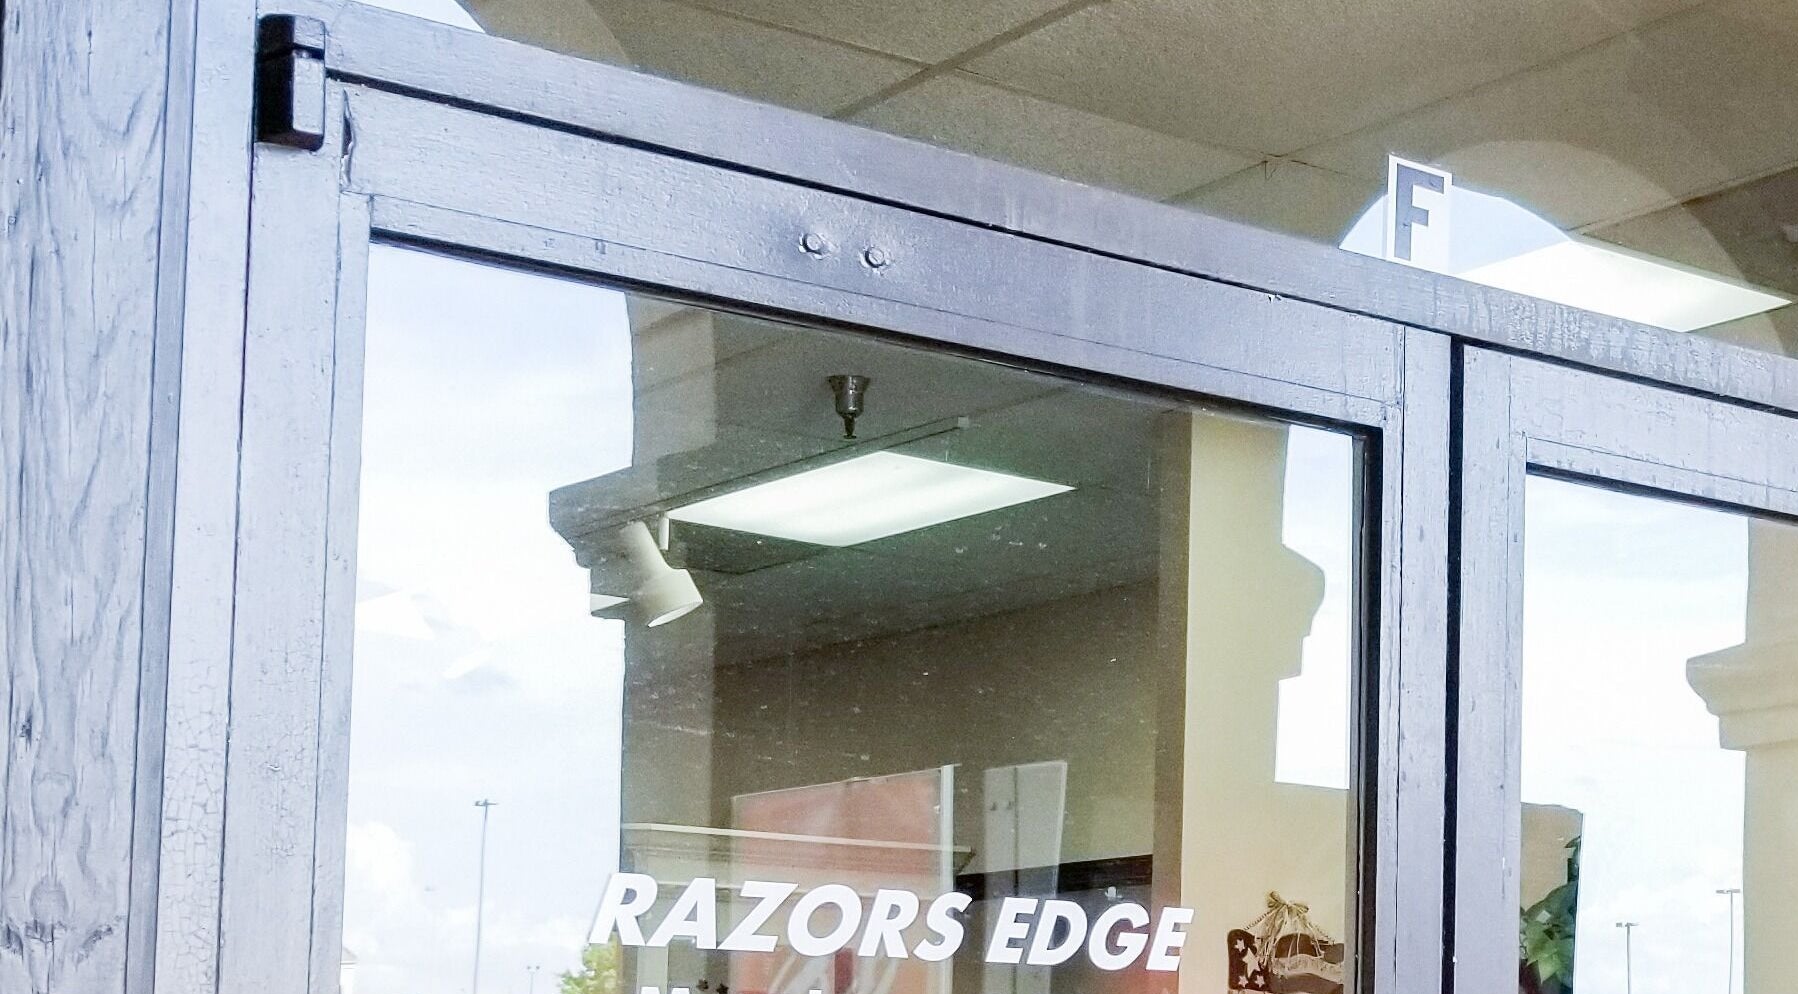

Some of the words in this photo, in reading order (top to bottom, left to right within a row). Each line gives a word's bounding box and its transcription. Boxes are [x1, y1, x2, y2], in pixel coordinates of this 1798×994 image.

[1394, 163, 1445, 262] F
[587, 872, 973, 961] RAZORS
[985, 896, 1194, 971] EDGE
